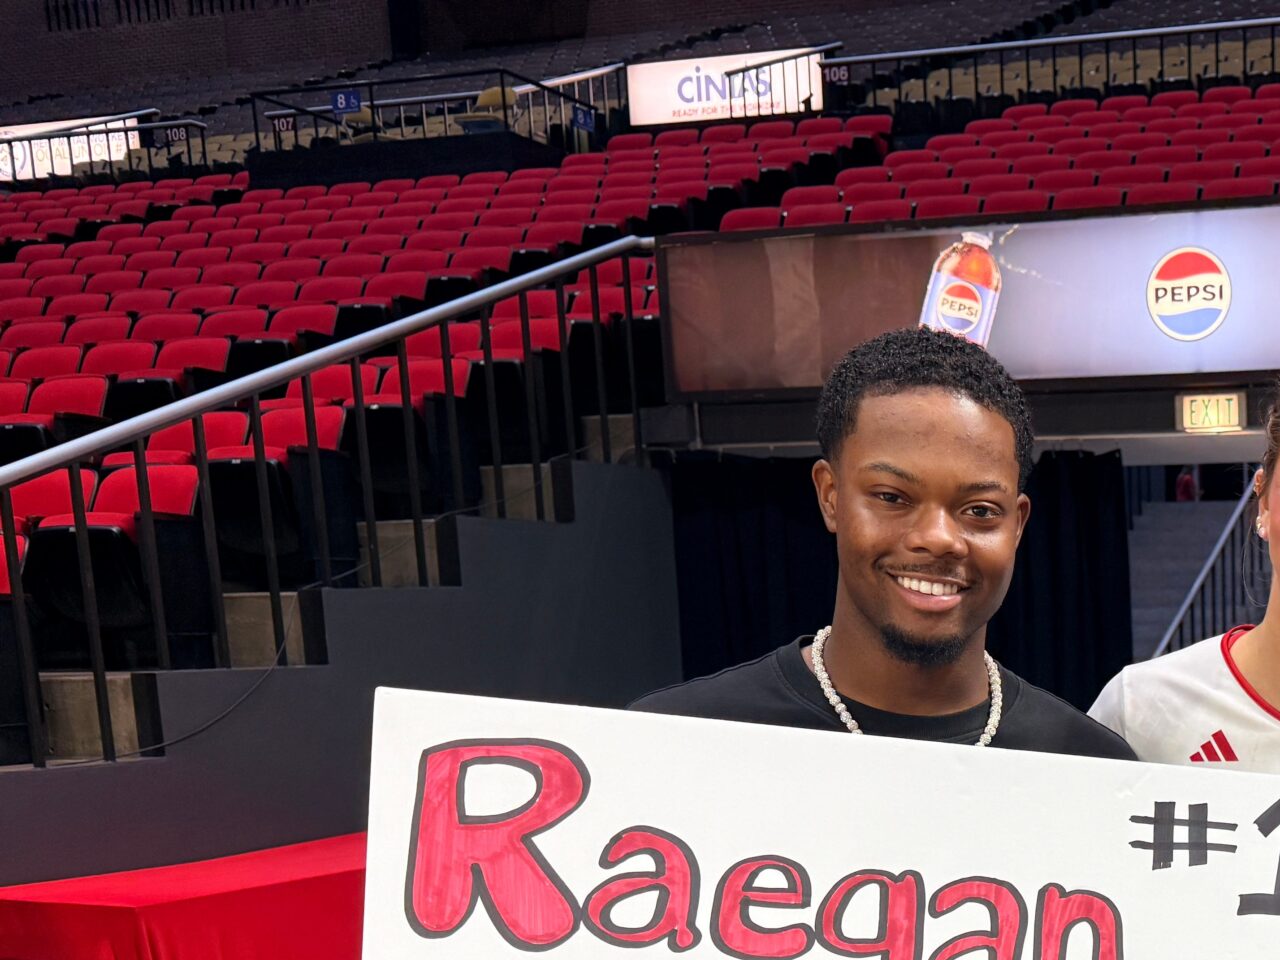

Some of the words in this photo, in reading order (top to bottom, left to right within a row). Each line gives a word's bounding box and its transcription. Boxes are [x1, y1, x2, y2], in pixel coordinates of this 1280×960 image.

[823, 66, 849, 82] 106
[337, 94, 346, 109] 8
[273, 118, 294, 132] 107
[166, 128, 187, 141] 108
[1154, 284, 1224, 304] PEPSI
[940, 297, 978, 319] PEPSI
[1190, 398, 1233, 426] EXIT
